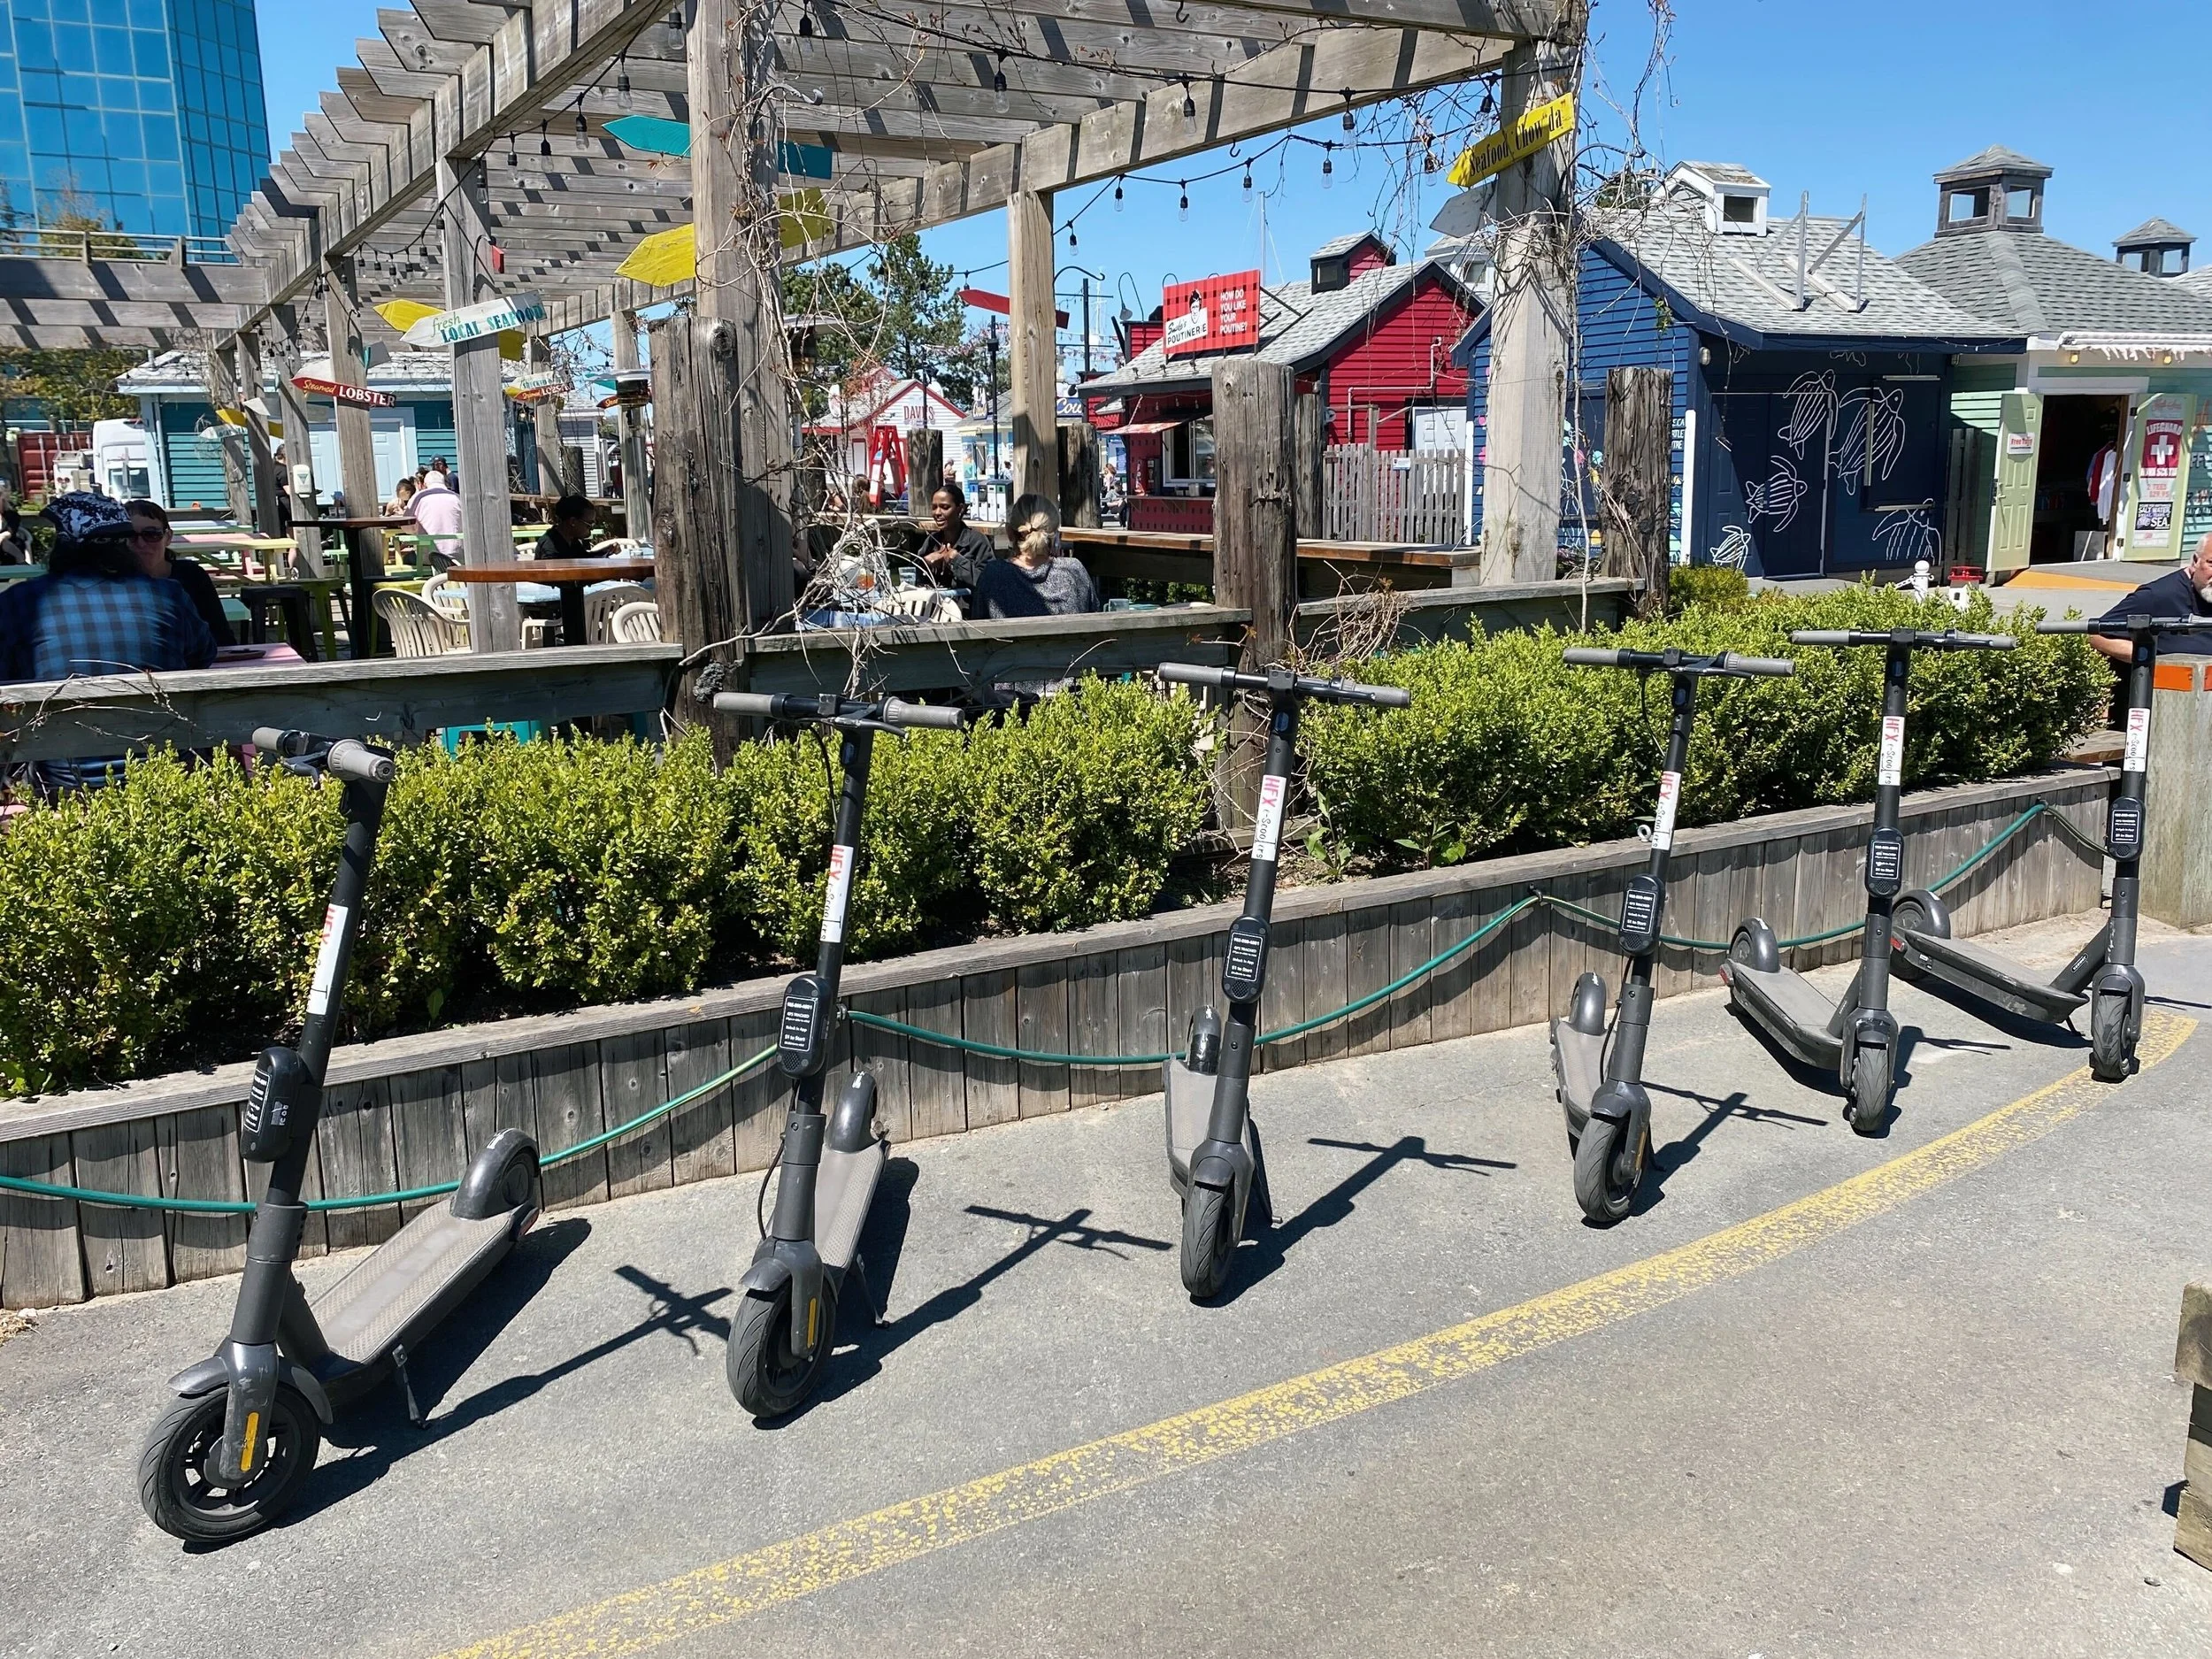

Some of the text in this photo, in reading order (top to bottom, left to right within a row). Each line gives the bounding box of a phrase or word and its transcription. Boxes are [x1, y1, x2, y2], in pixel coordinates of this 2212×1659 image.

[1470, 133, 1509, 176] Seafood
[1220, 288, 1244, 301] HOW DO
[1220, 299, 1247, 312] YOU LIKE
[431, 311, 461, 337] fresh
[441, 304, 547, 342] LOCAL SEAFOOD
[1219, 322, 1248, 334] POUTINE?
[1220, 312, 1236, 324] YOUR
[1168, 323, 1207, 345] POUTINERIE
[303, 380, 396, 406] Steamed LOBSTER
[2147, 422, 2183, 435] LIFEGUARD
[1885, 718, 1900, 741] HFX
[2130, 710, 2144, 732] HFX
[1262, 777, 1280, 808] HFX
[1659, 772, 1674, 800] HFX
